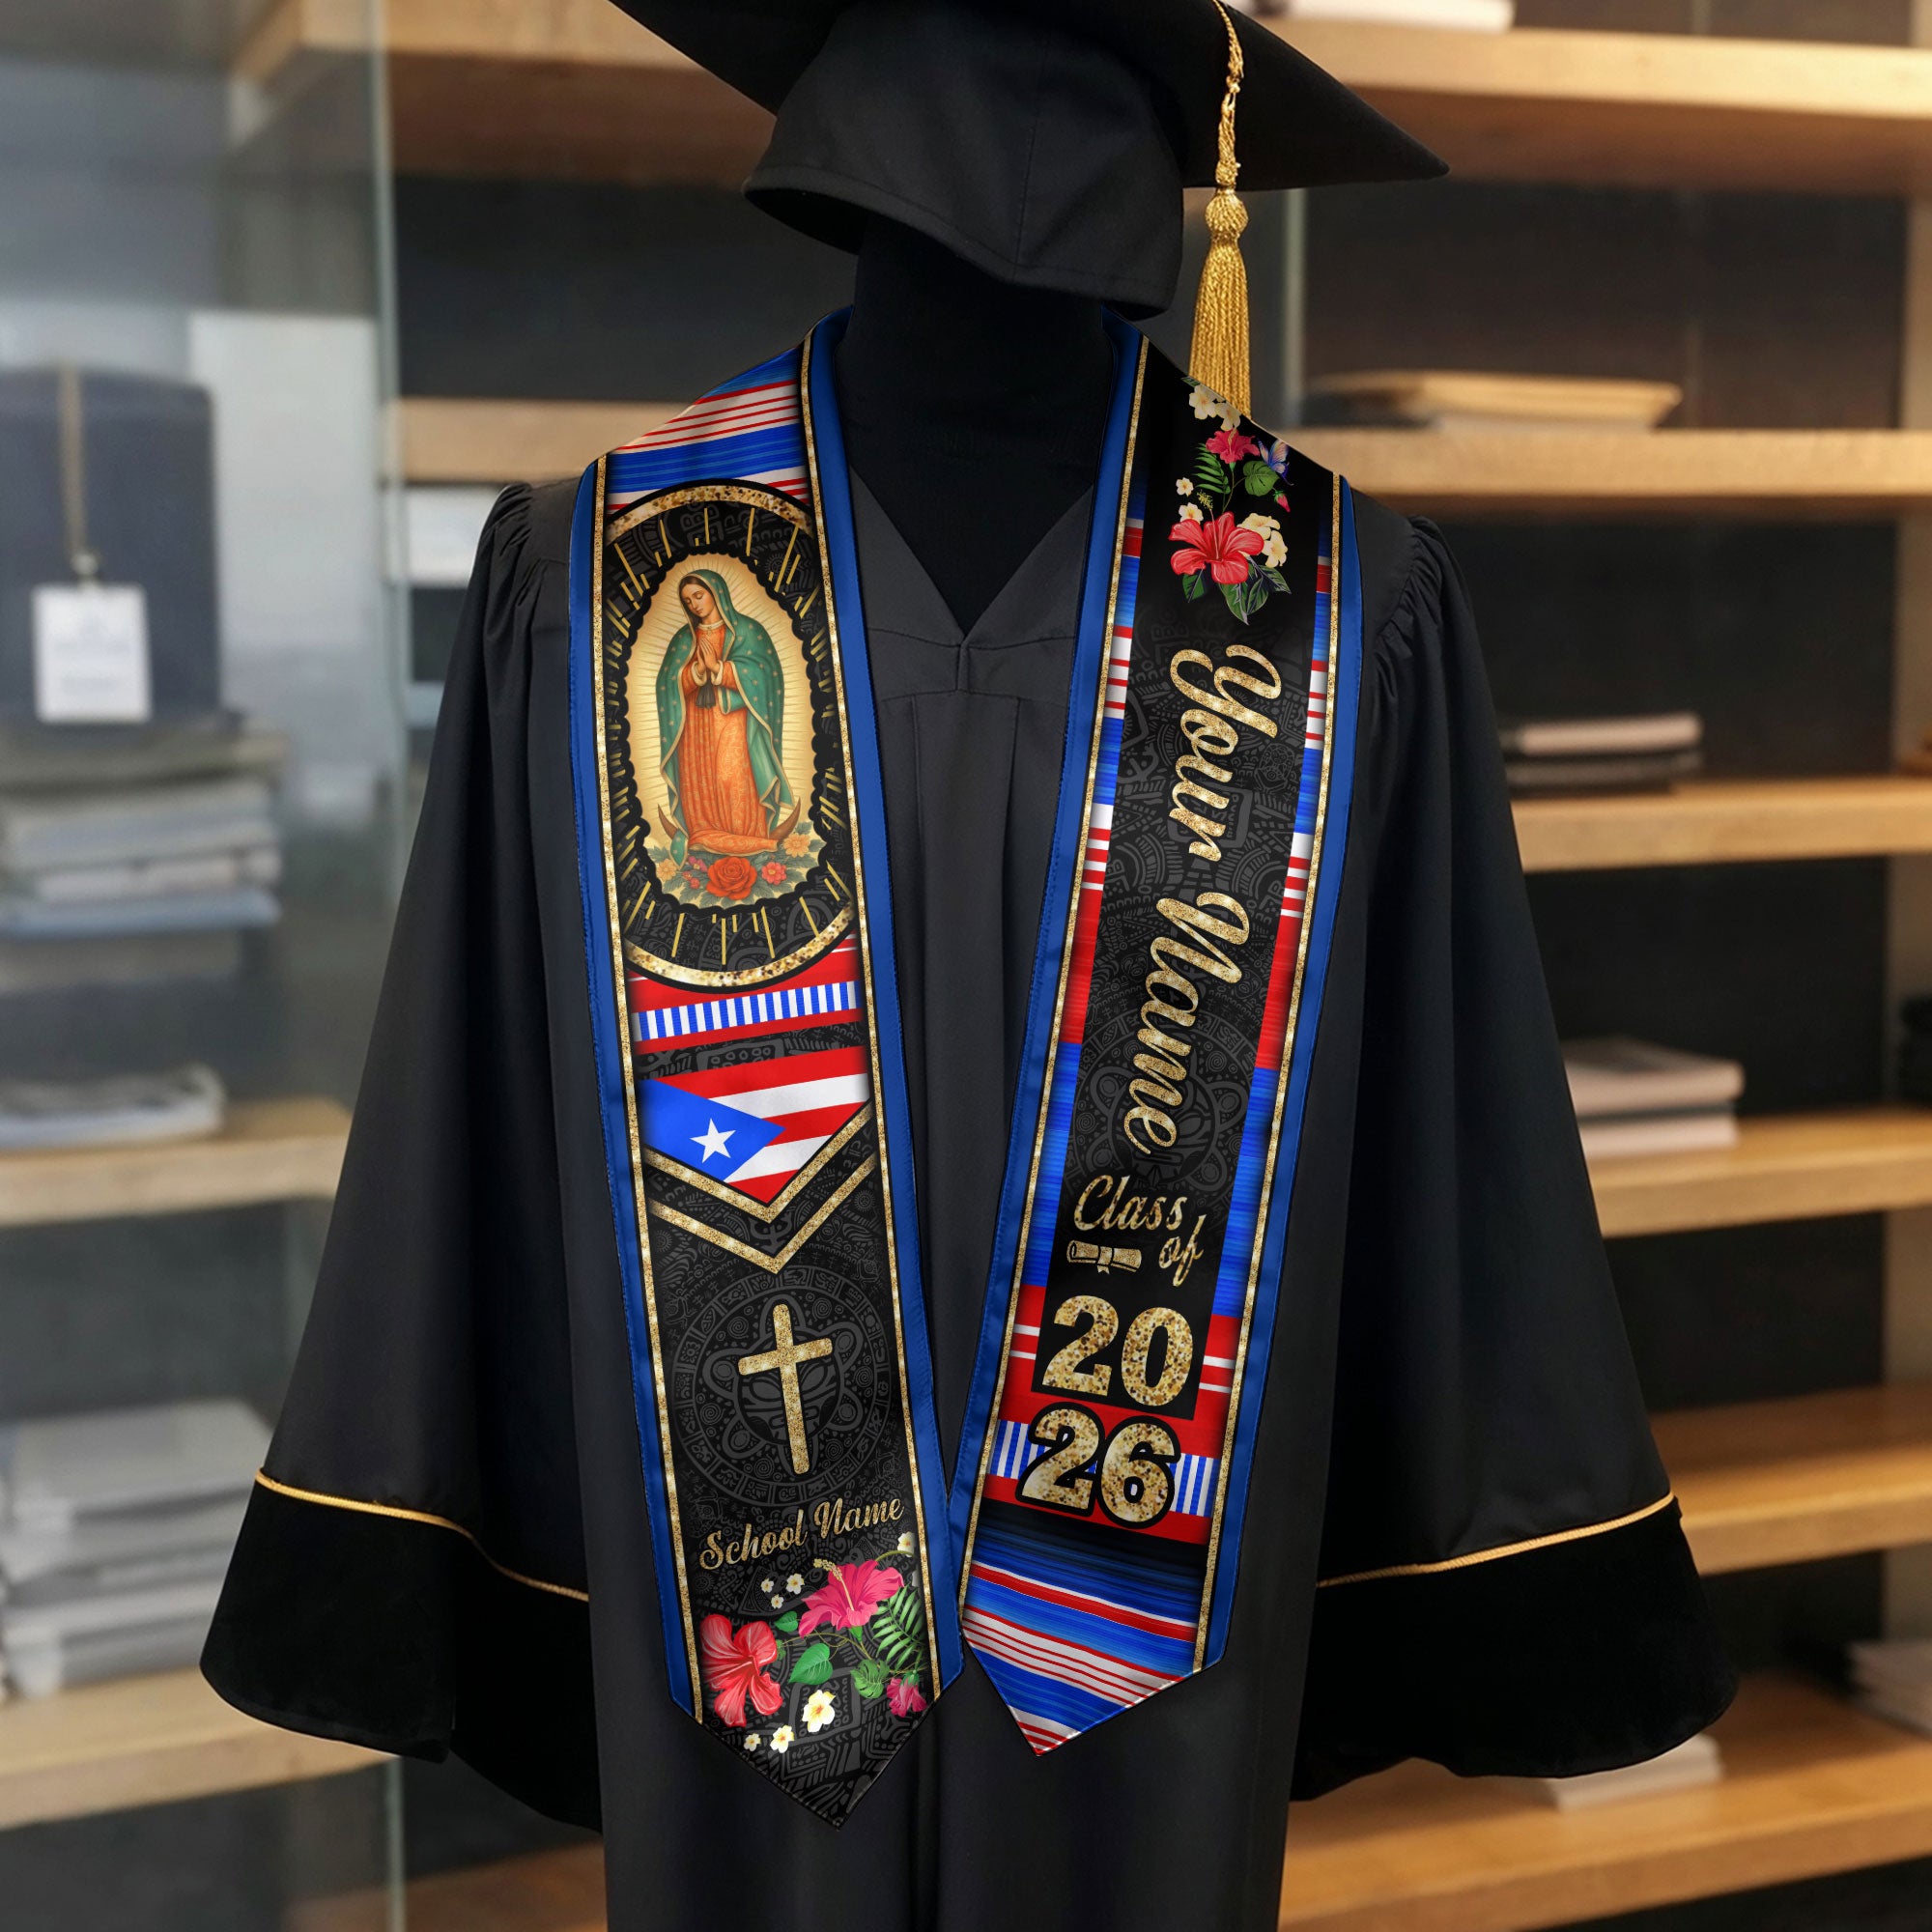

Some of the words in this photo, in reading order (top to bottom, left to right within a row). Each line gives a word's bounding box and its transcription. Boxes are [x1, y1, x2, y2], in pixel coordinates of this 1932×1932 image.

[1170, 644, 1283, 862] Your
[1122, 892, 1250, 1154] Name
[1073, 1174, 1188, 1231] Class
[1158, 1214, 1205, 1287] of
[1042, 1294, 1194, 1407] 20
[1020, 1407, 1177, 1523] 26
[698, 1508, 809, 1571] School
[813, 1497, 905, 1539] Name
